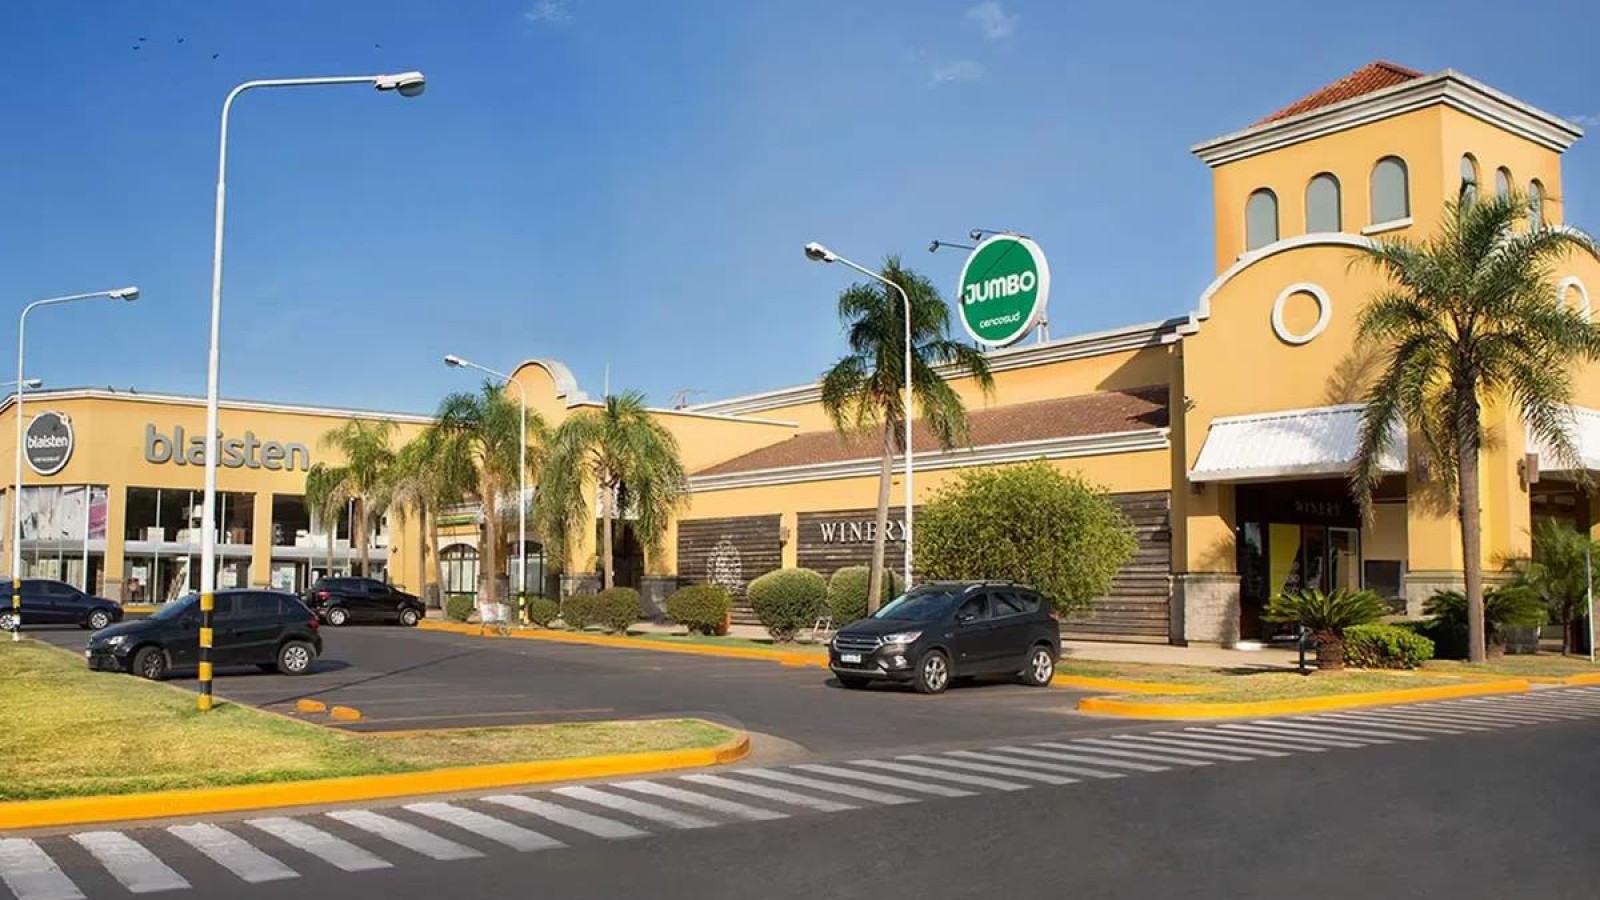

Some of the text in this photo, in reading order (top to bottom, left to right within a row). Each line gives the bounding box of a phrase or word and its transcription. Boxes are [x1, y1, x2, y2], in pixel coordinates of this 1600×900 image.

[965, 271, 1036, 305] JUMBO
[979, 311, 1021, 329] cencosud
[27, 435, 69, 449] blaisten
[145, 423, 309, 471] blaisten
[819, 520, 908, 543] WINERY
